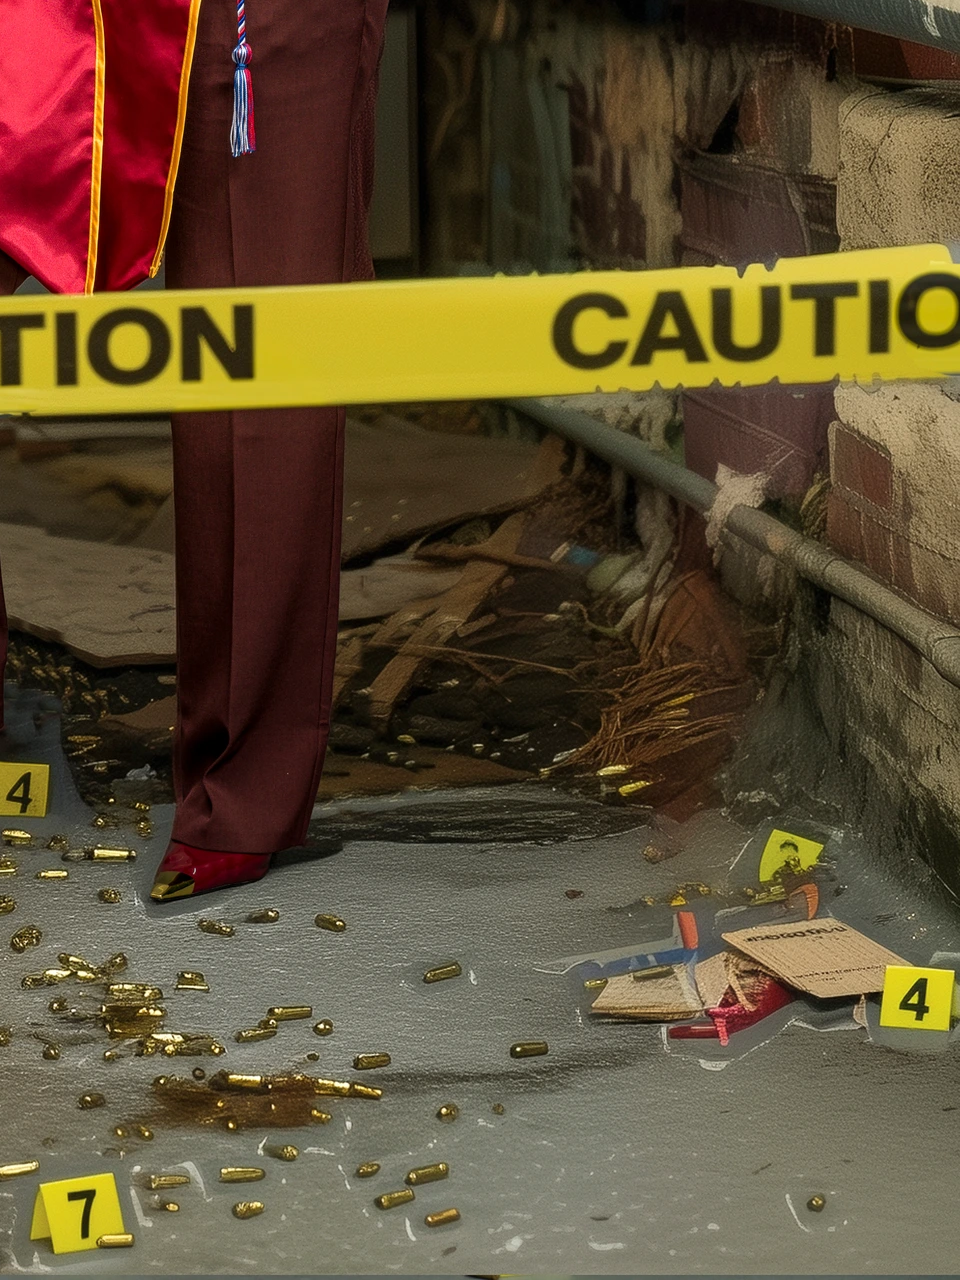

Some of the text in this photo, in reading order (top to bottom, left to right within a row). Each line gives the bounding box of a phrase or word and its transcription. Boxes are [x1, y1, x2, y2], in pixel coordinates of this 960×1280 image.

[6, 771, 33, 814] 4
[898, 977, 930, 1022] 4
[67, 1189, 96, 1240] 7
